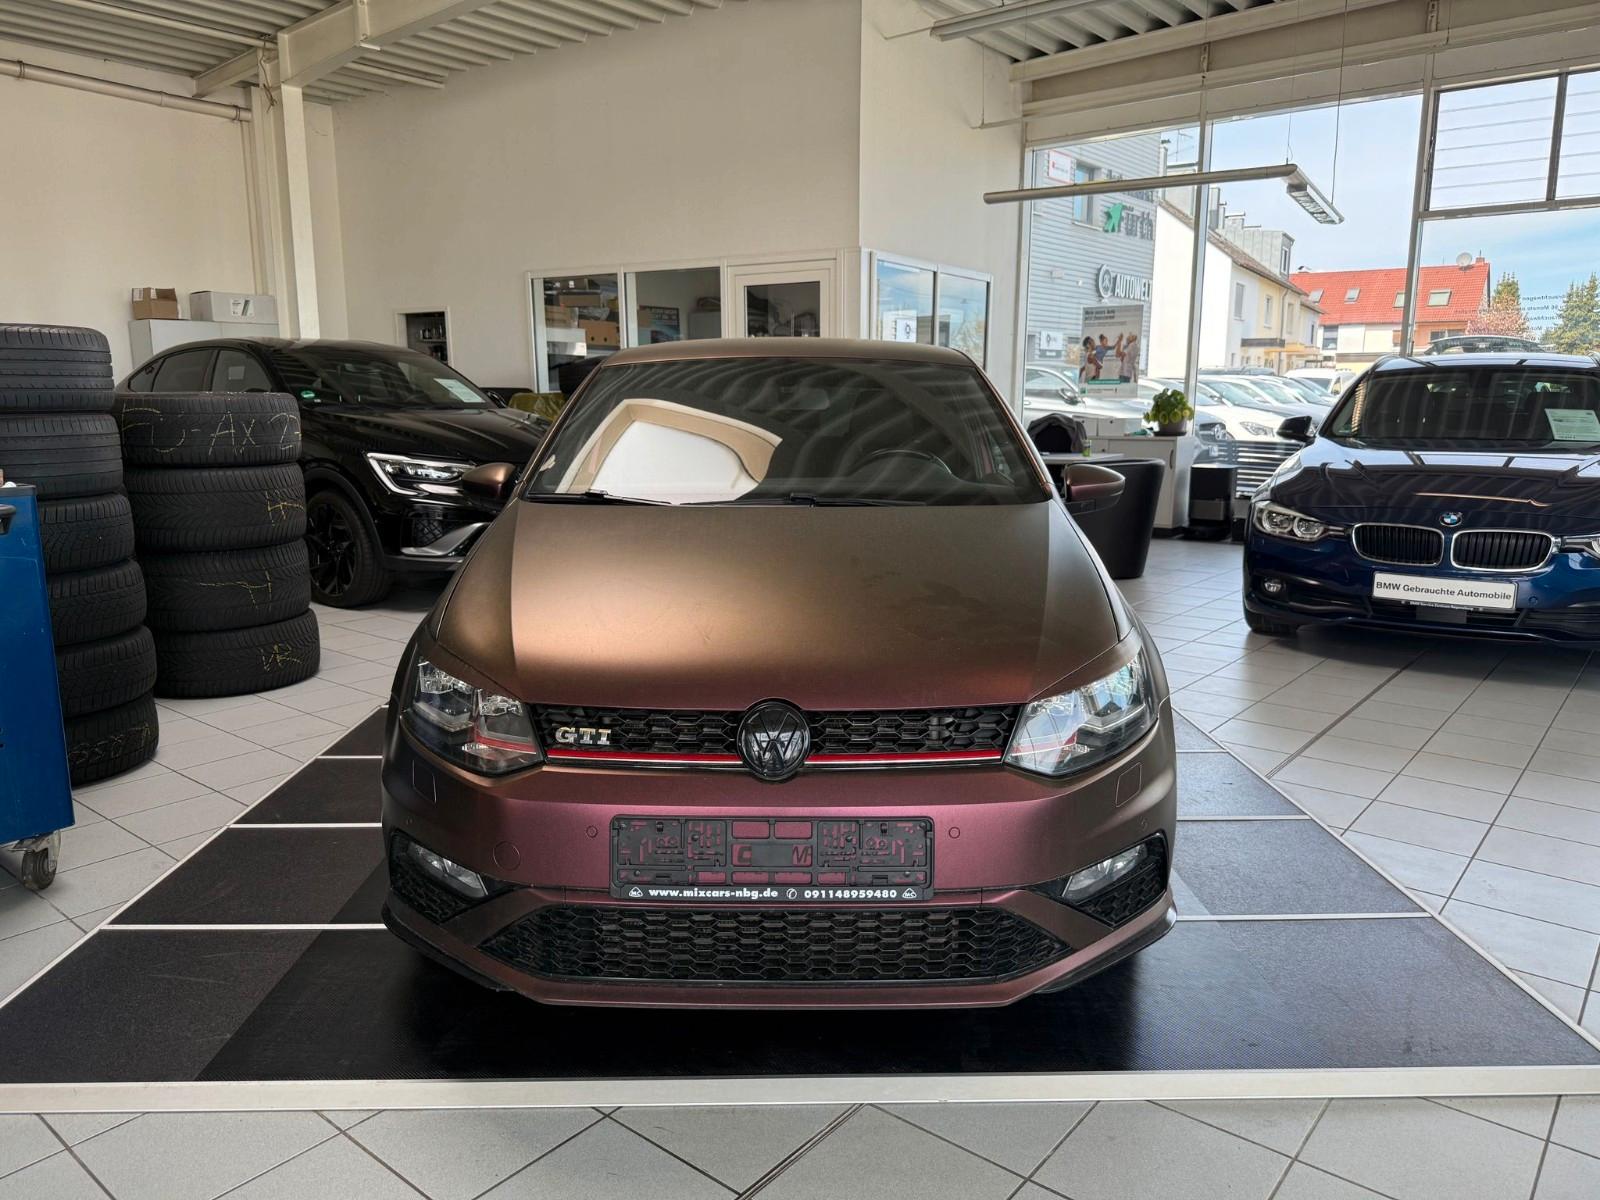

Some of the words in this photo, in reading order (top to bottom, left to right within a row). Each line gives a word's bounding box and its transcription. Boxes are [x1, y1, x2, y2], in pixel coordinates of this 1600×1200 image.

[1115, 274, 1152, 302] AUTOWELT
[1376, 581, 1401, 591] BMW
[1402, 585, 1456, 596] Gebrauchte
[1457, 589, 1512, 600] Automobile
[555, 726, 612, 745] GTI
[648, 887, 779, 900] www.mixcars-nbg.de
[803, 888, 897, 899] 091148959480
